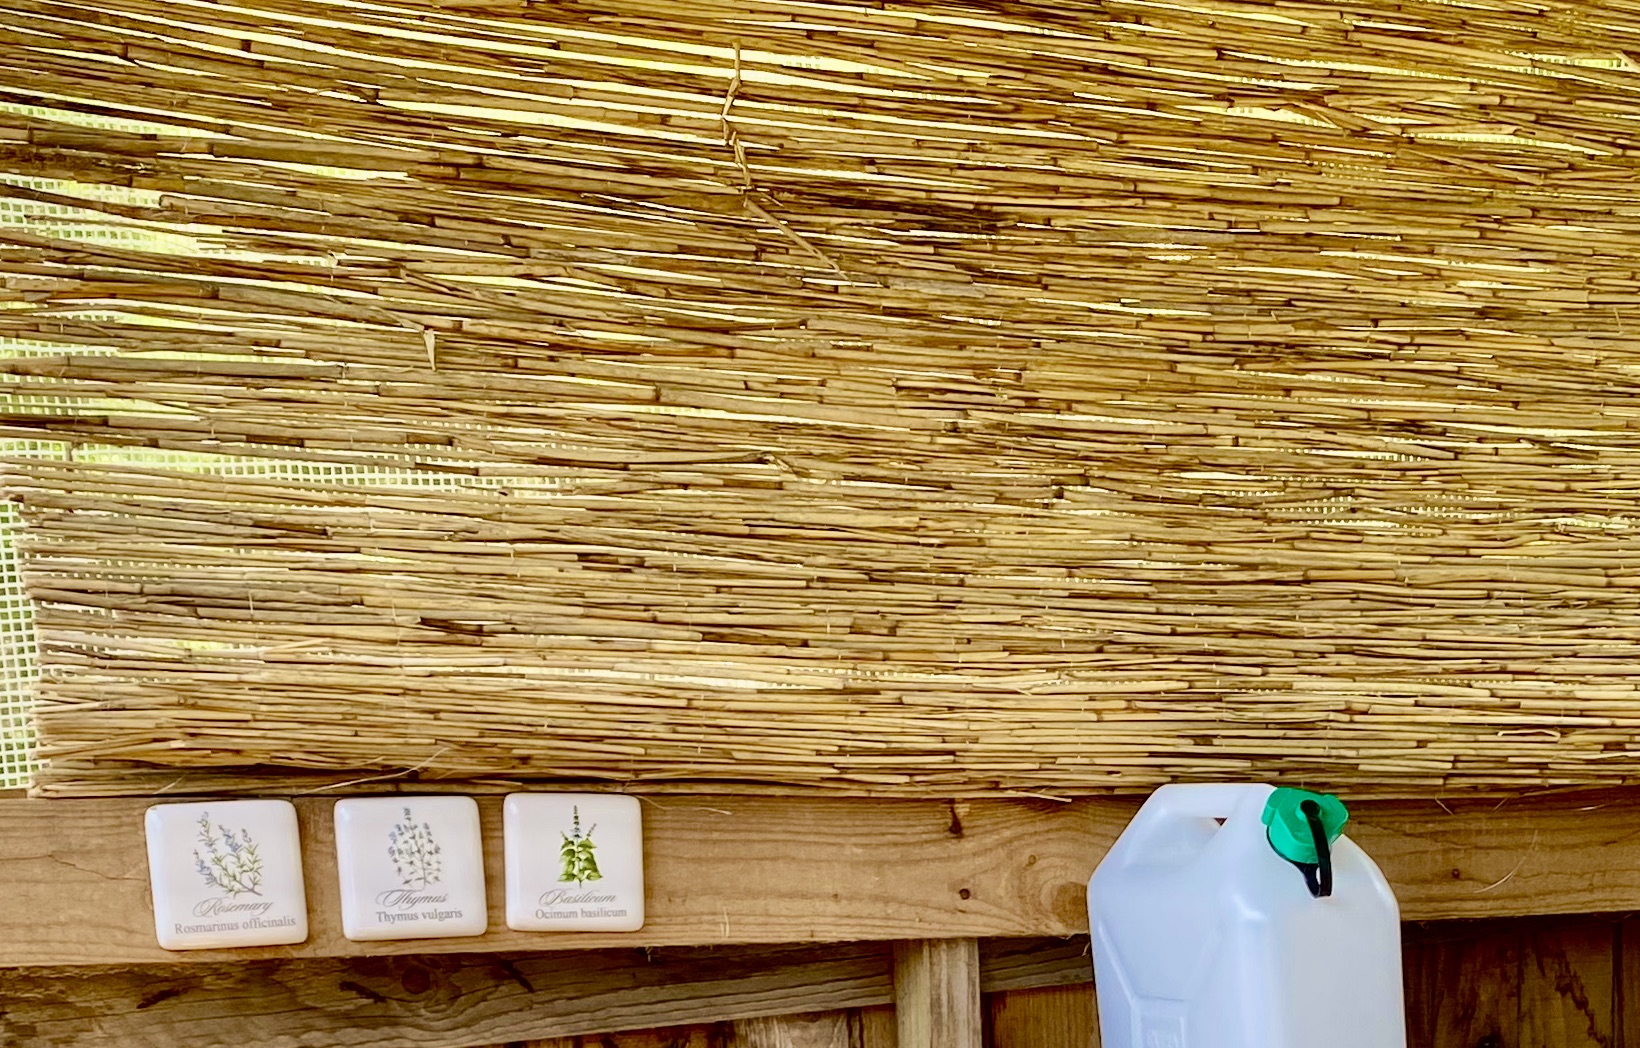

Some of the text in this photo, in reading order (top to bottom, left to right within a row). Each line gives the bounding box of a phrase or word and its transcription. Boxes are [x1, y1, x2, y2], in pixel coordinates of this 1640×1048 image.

[193, 897, 273, 918] Rosemary
[375, 889, 449, 911] Thymus
[376, 908, 463, 924] Thymus vulgaris
[535, 908, 628, 919] Ocimum basilicum
[175, 916, 296, 934] Rosmarinus officinalis
